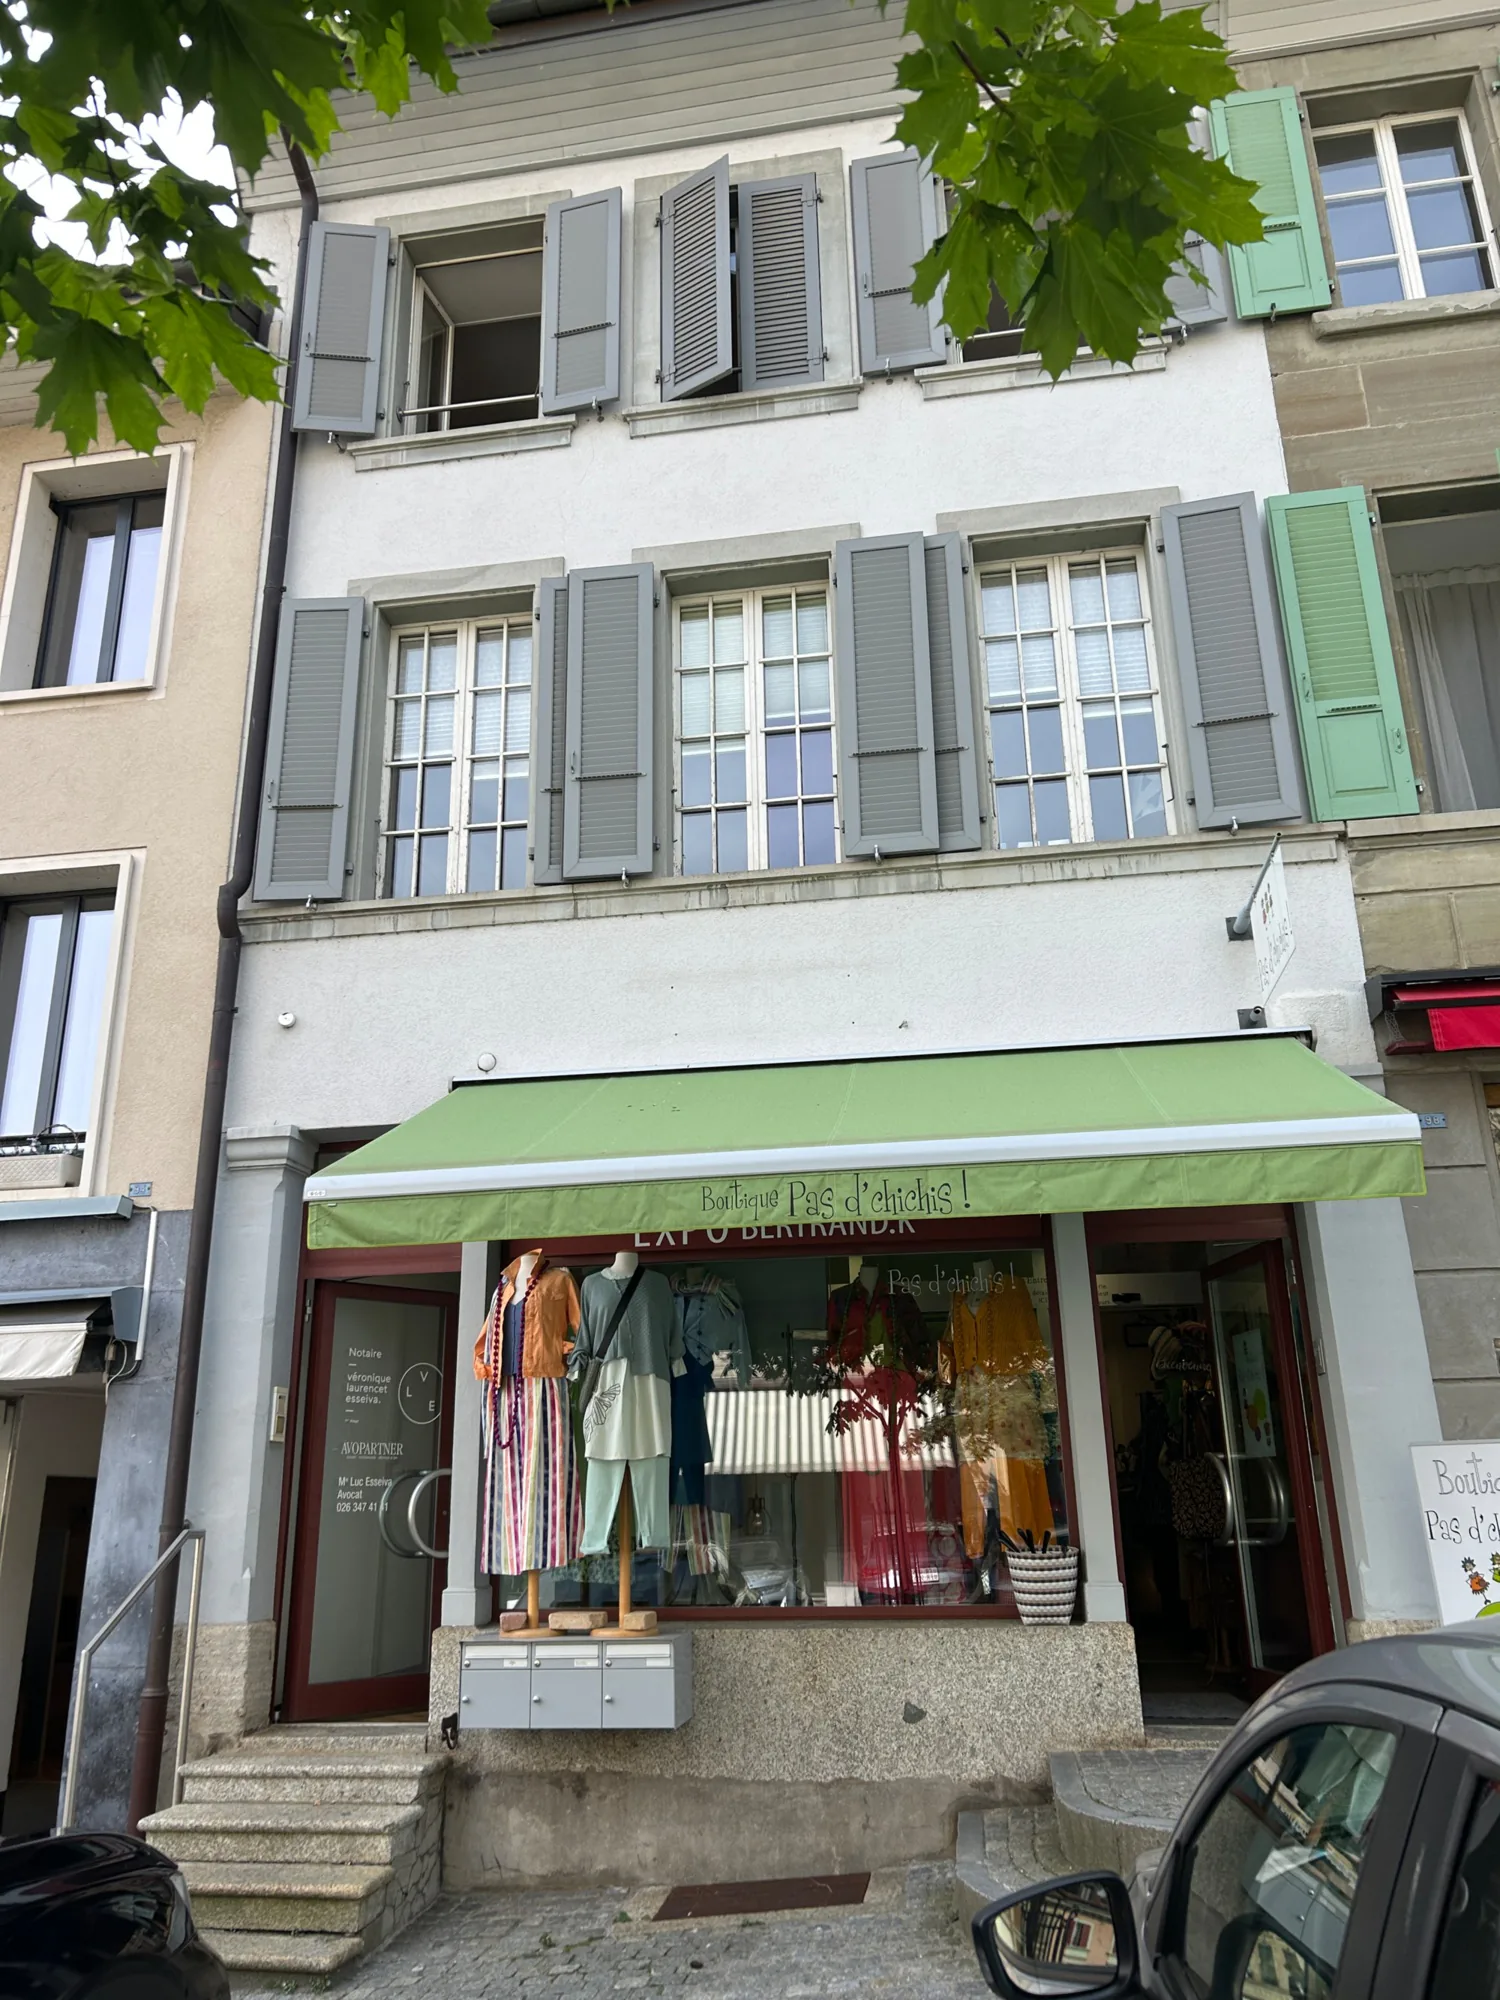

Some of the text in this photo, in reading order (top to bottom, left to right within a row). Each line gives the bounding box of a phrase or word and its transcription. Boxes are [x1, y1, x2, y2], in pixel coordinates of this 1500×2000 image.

[1424, 1115, 1440, 1125] 98
[701, 1180, 779, 1220] Boutique
[787, 1180, 834, 1220] Pas
[844, 1172, 953, 1216] d'chichis
[887, 1269, 922, 1297] Pas
[348, 1347, 382, 1359] Notaire
[347, 1371, 391, 1384] véronique
[419, 1371, 429, 1382] V
[346, 1382, 388, 1393] laurencet
[406, 1386, 413, 1397] L
[345, 1394, 381, 1404] esseiva.
[428, 1400, 436, 1411] E
[341, 1441, 404, 1456] AVOPARTNER
[350, 1476, 364, 1487] Luc
[365, 1476, 393, 1487] Esseiva
[337, 1489, 363, 1500] Avocat
[336, 1502, 351, 1512] 026
[352, 1502, 367, 1513] 347
[368, 1501, 378, 1512] 41
[1424, 1509, 1462, 1544] Pas
